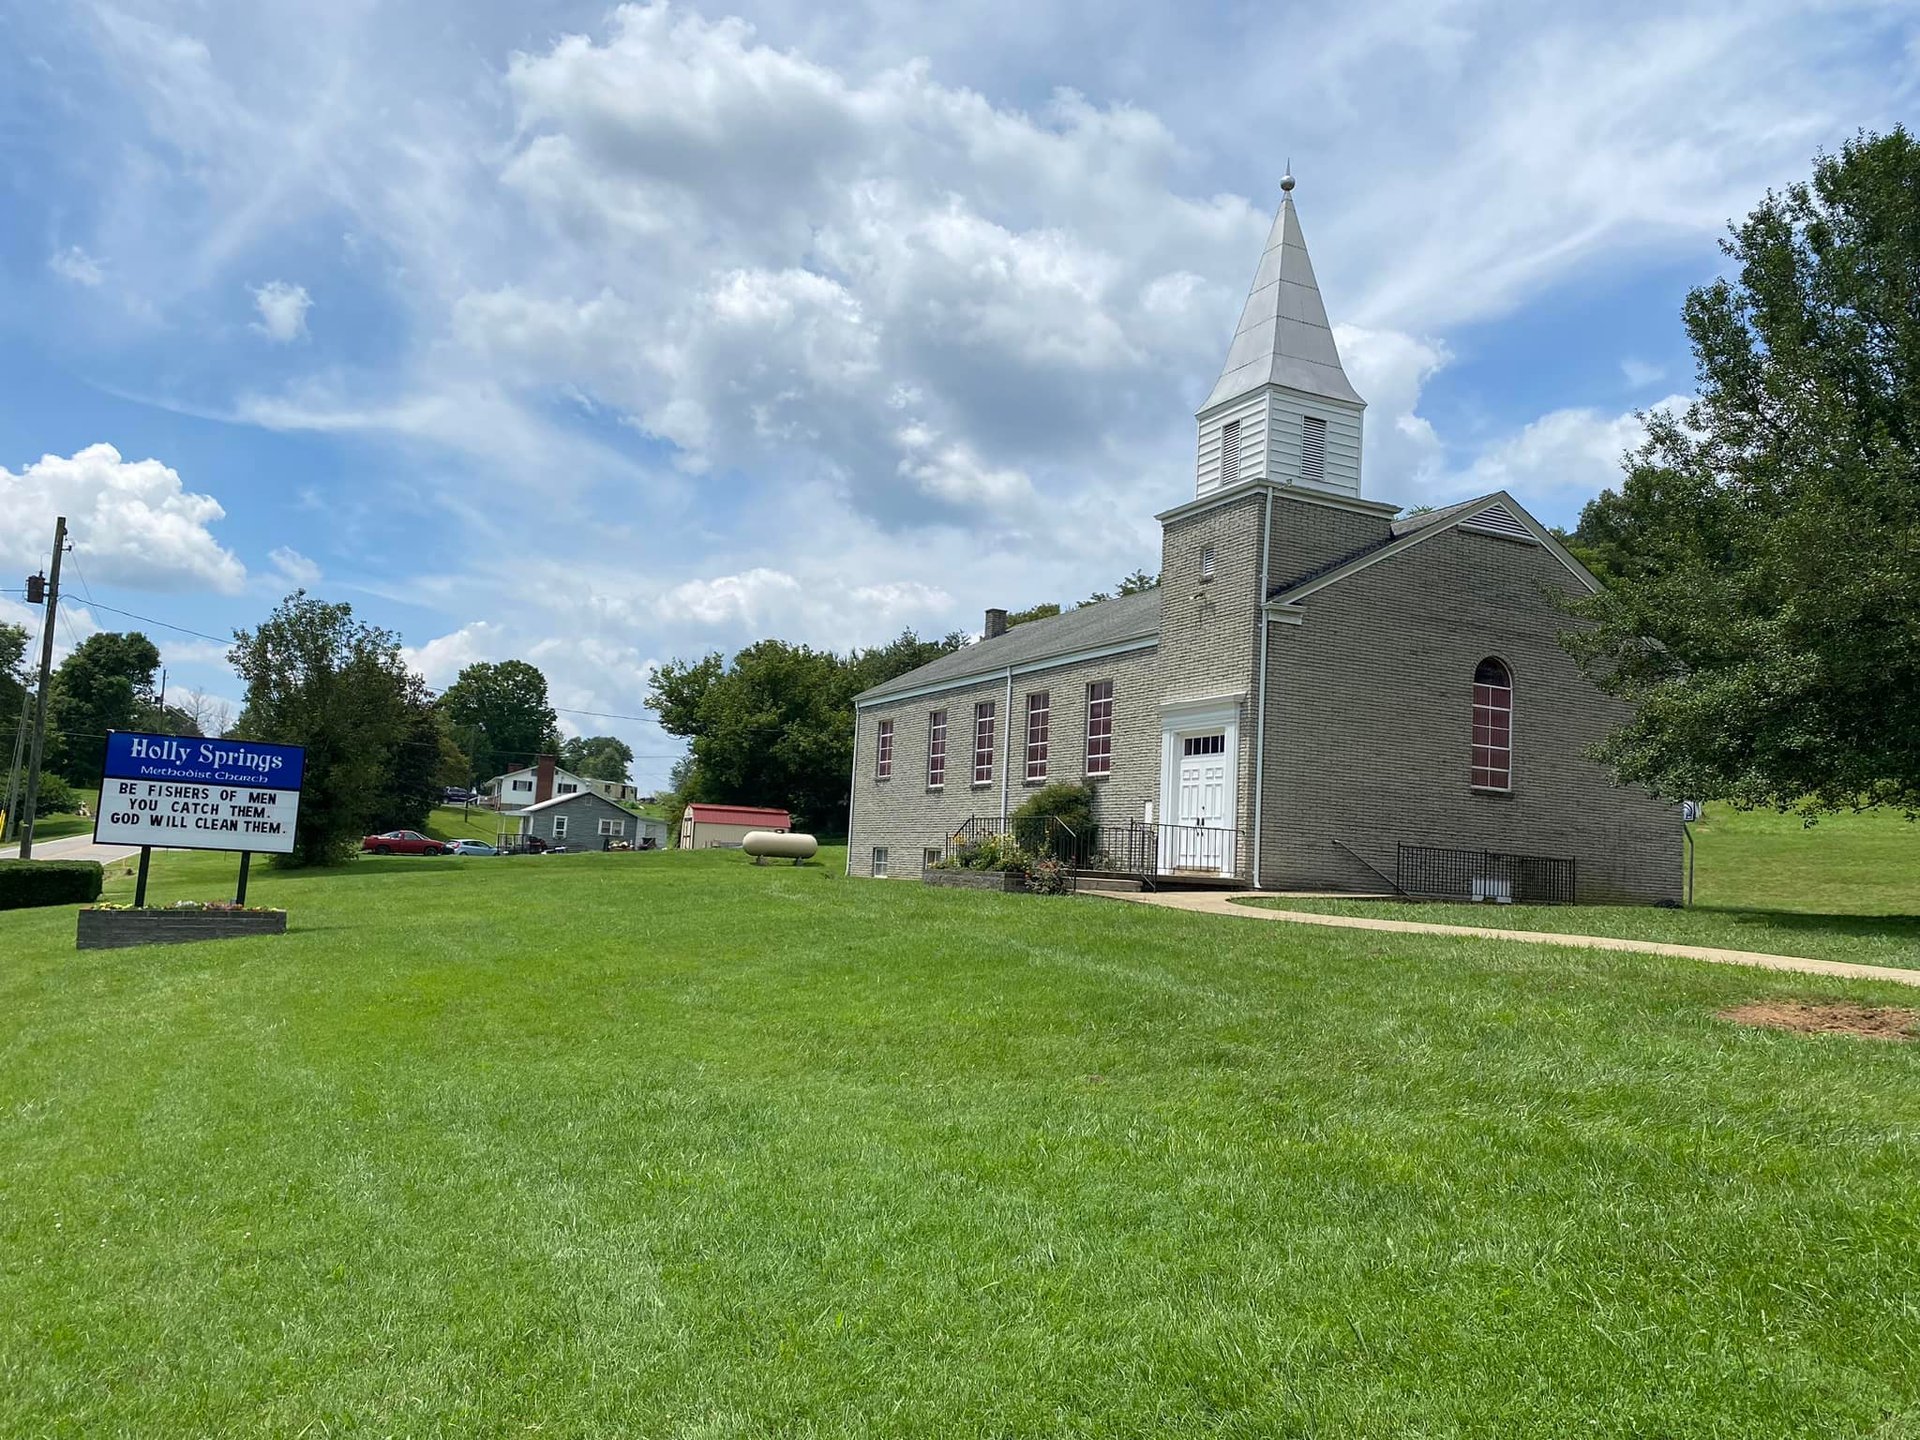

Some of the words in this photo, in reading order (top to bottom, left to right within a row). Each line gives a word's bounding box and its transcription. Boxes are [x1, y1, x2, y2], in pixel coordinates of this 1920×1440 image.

[131, 738, 192, 766] Holly
[198, 743, 283, 772] Springs
[140, 765, 211, 779] Methodist
[215, 771, 268, 783] Church
[119, 783, 137, 795] BE
[148, 785, 209, 799] FISHERS
[220, 789, 237, 801] OF
[248, 792, 276, 804] MEN
[129, 799, 158, 811] YOU
[171, 801, 219, 815] CATCH
[230, 805, 271, 818] THEM.
[111, 812, 140, 825] GOD
[150, 815, 187, 828] WILL
[195, 817, 238, 831] CLEAN
[243, 821, 287, 834] THEM.
